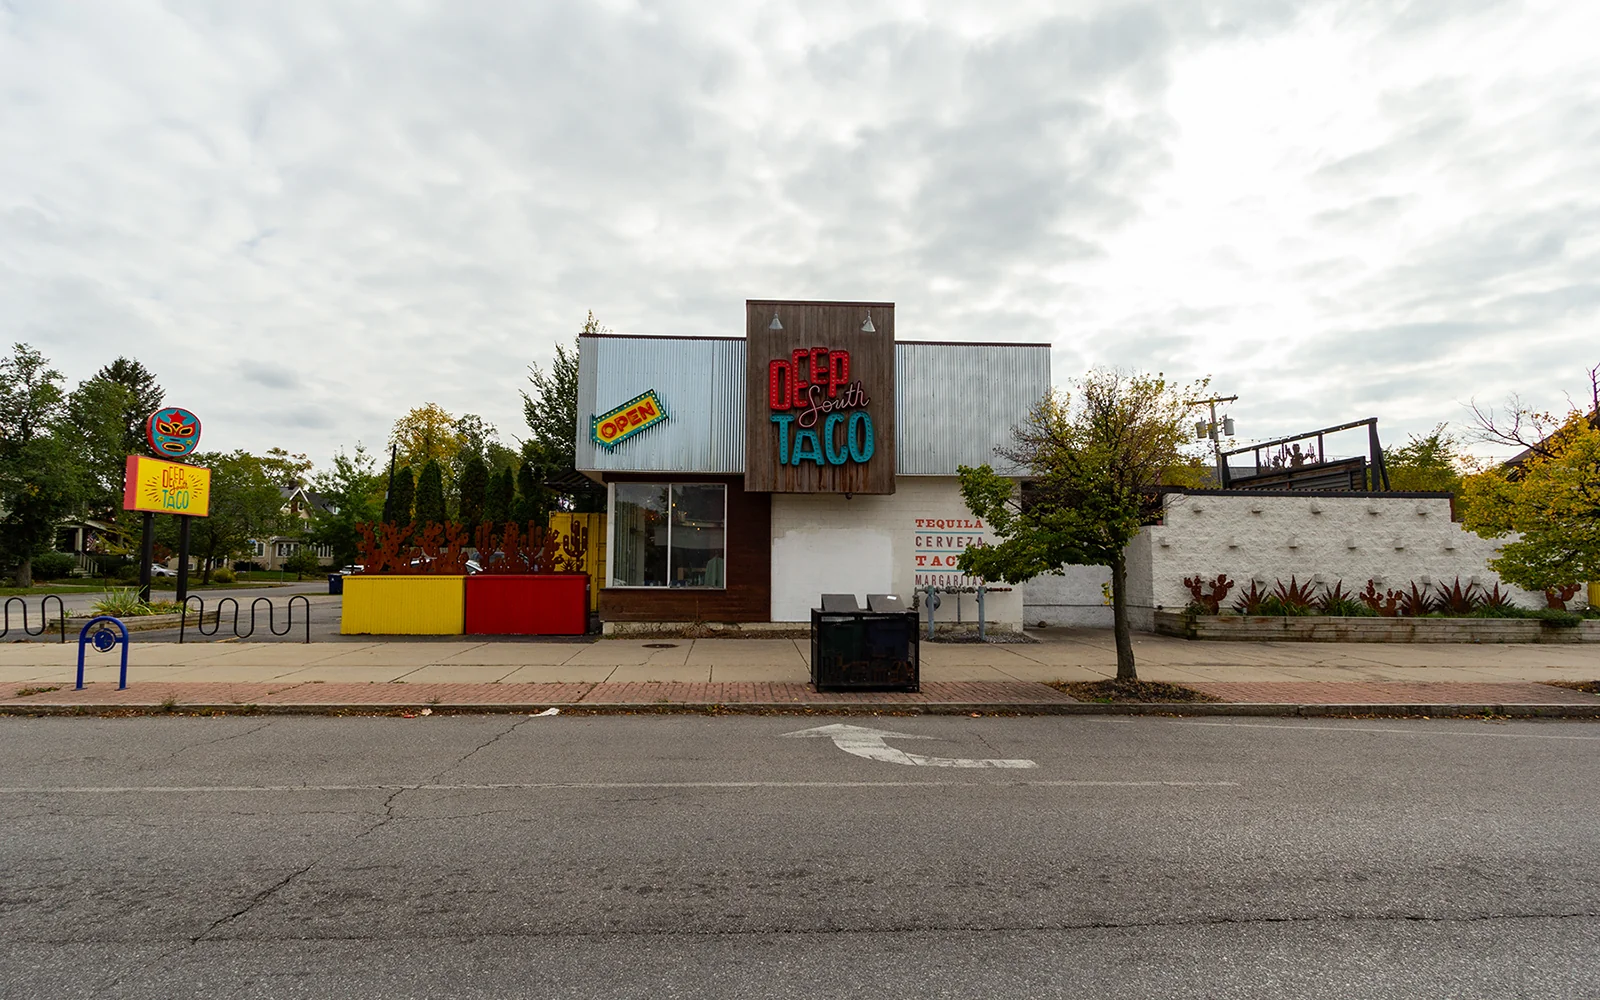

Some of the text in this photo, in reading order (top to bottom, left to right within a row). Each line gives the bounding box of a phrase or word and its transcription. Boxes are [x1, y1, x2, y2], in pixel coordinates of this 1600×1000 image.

[769, 347, 850, 410] DEEP
[798, 380, 870, 428] South
[601, 401, 656, 439] OPEN
[769, 411, 875, 465] TACO
[162, 466, 184, 488] DEEP
[162, 489, 190, 510] TACO
[915, 519, 984, 530] TEQUILA
[915, 536, 984, 548] CERVEZA
[915, 555, 957, 567] TAC
